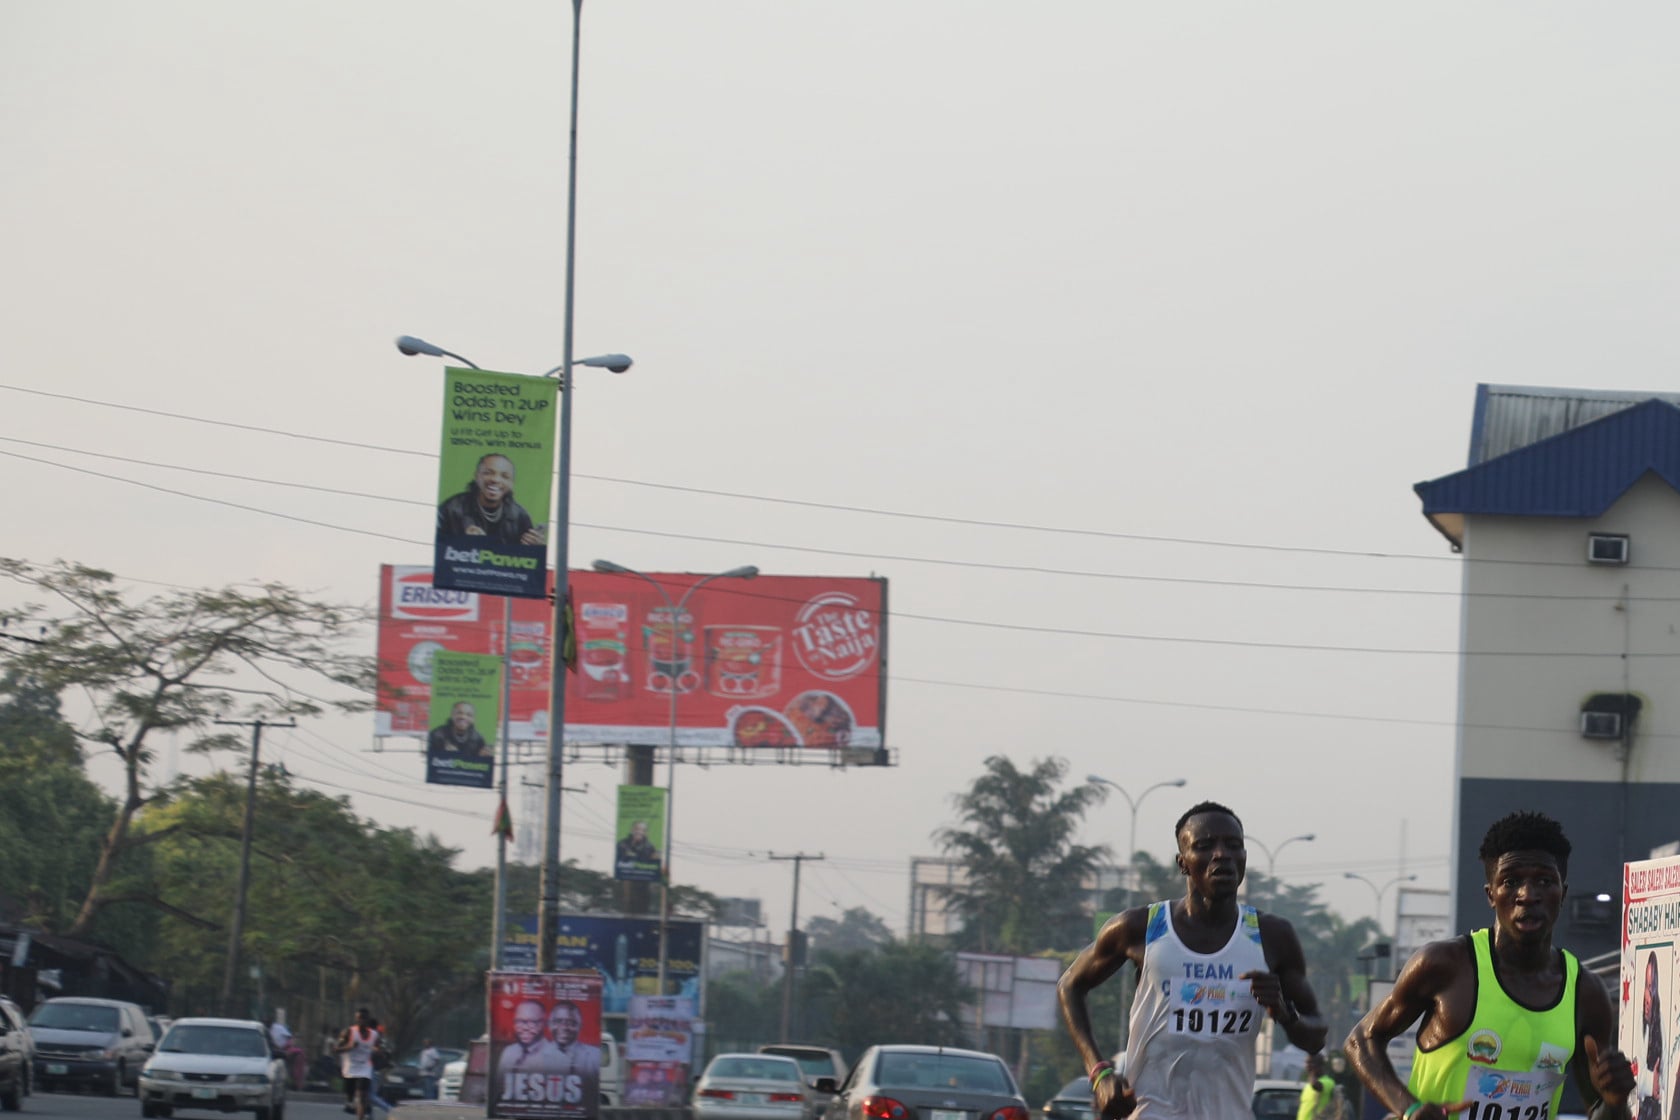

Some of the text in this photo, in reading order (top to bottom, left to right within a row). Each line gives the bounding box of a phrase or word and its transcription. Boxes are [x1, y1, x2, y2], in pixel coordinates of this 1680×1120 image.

[454, 381, 520, 396] Boosted
[453, 395, 496, 408] Odds
[518, 399, 549, 411] 2UP
[452, 409, 525, 426] Wins Dey
[444, 546, 538, 569] betPawa
[792, 610, 872, 652] Taste
[818, 633, 875, 661] Naija
[1628, 904, 1663, 935] SHABABY
[1183, 963, 1234, 979] TEAM
[1173, 1008, 1253, 1034] 10122
[501, 1072, 583, 1103] JESUS
